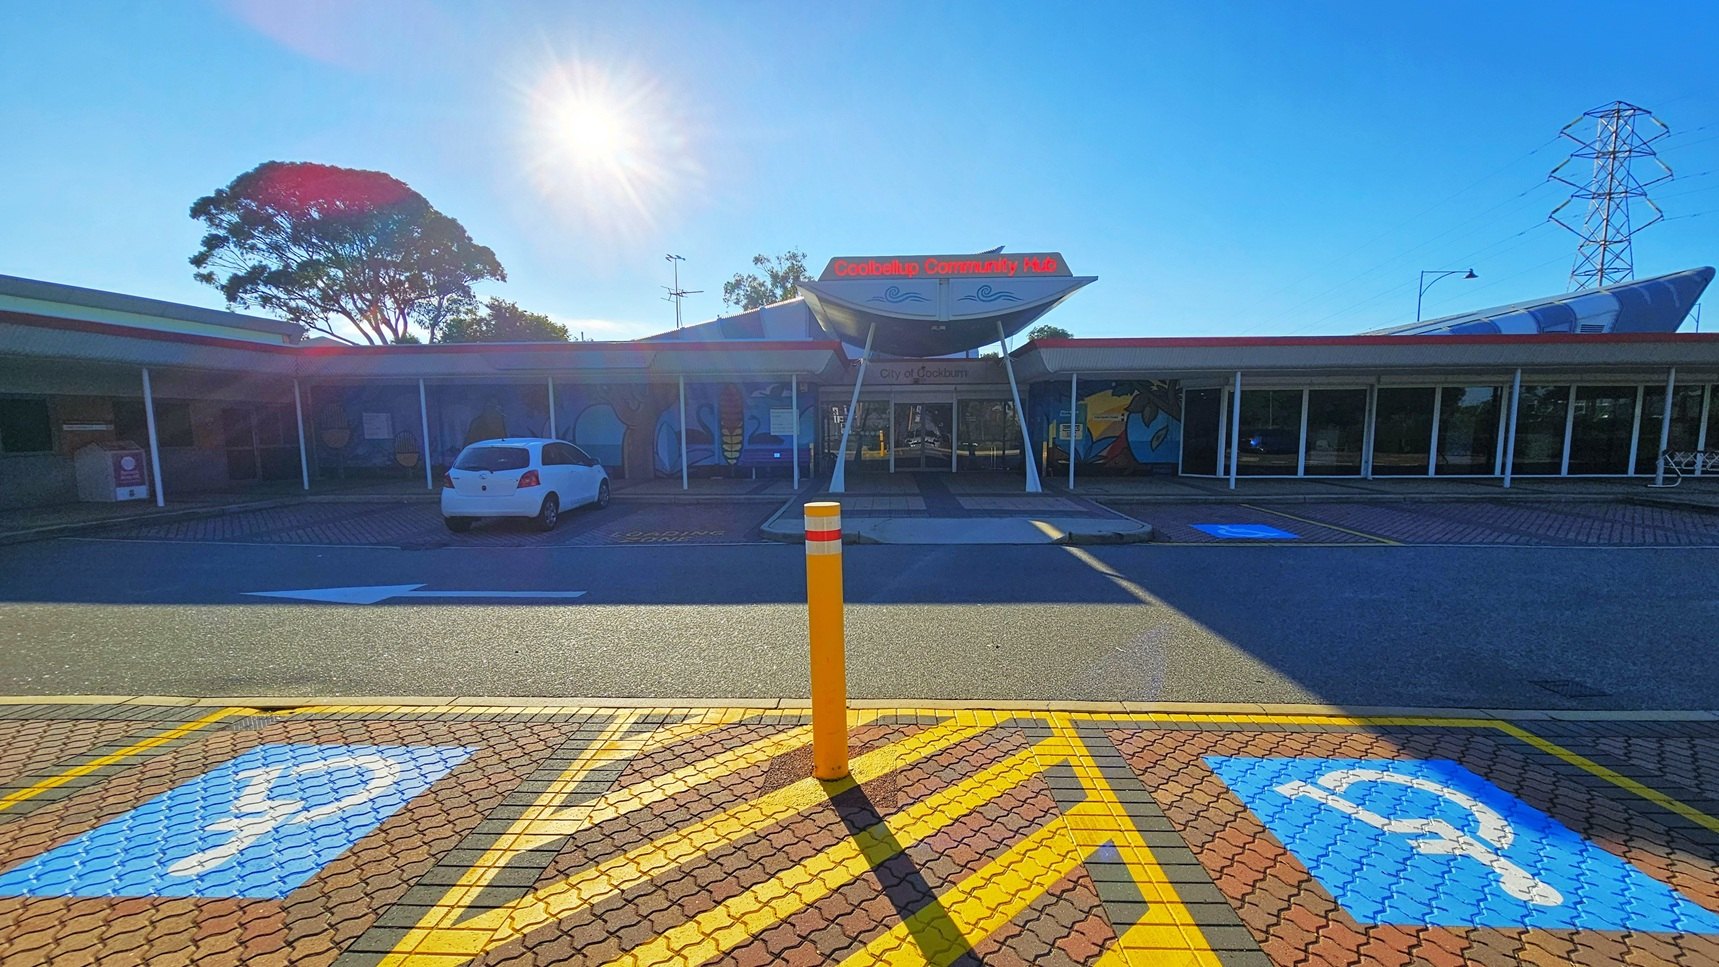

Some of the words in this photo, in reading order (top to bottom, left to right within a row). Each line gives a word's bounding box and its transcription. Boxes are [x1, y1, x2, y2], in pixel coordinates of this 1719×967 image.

[834, 260, 919, 277] Coolbellup
[924, 257, 1018, 276] Community
[1024, 256, 1056, 273] Hub
[880, 368, 900, 380] City
[904, 368, 914, 378] of
[917, 368, 968, 379] Cockburn
